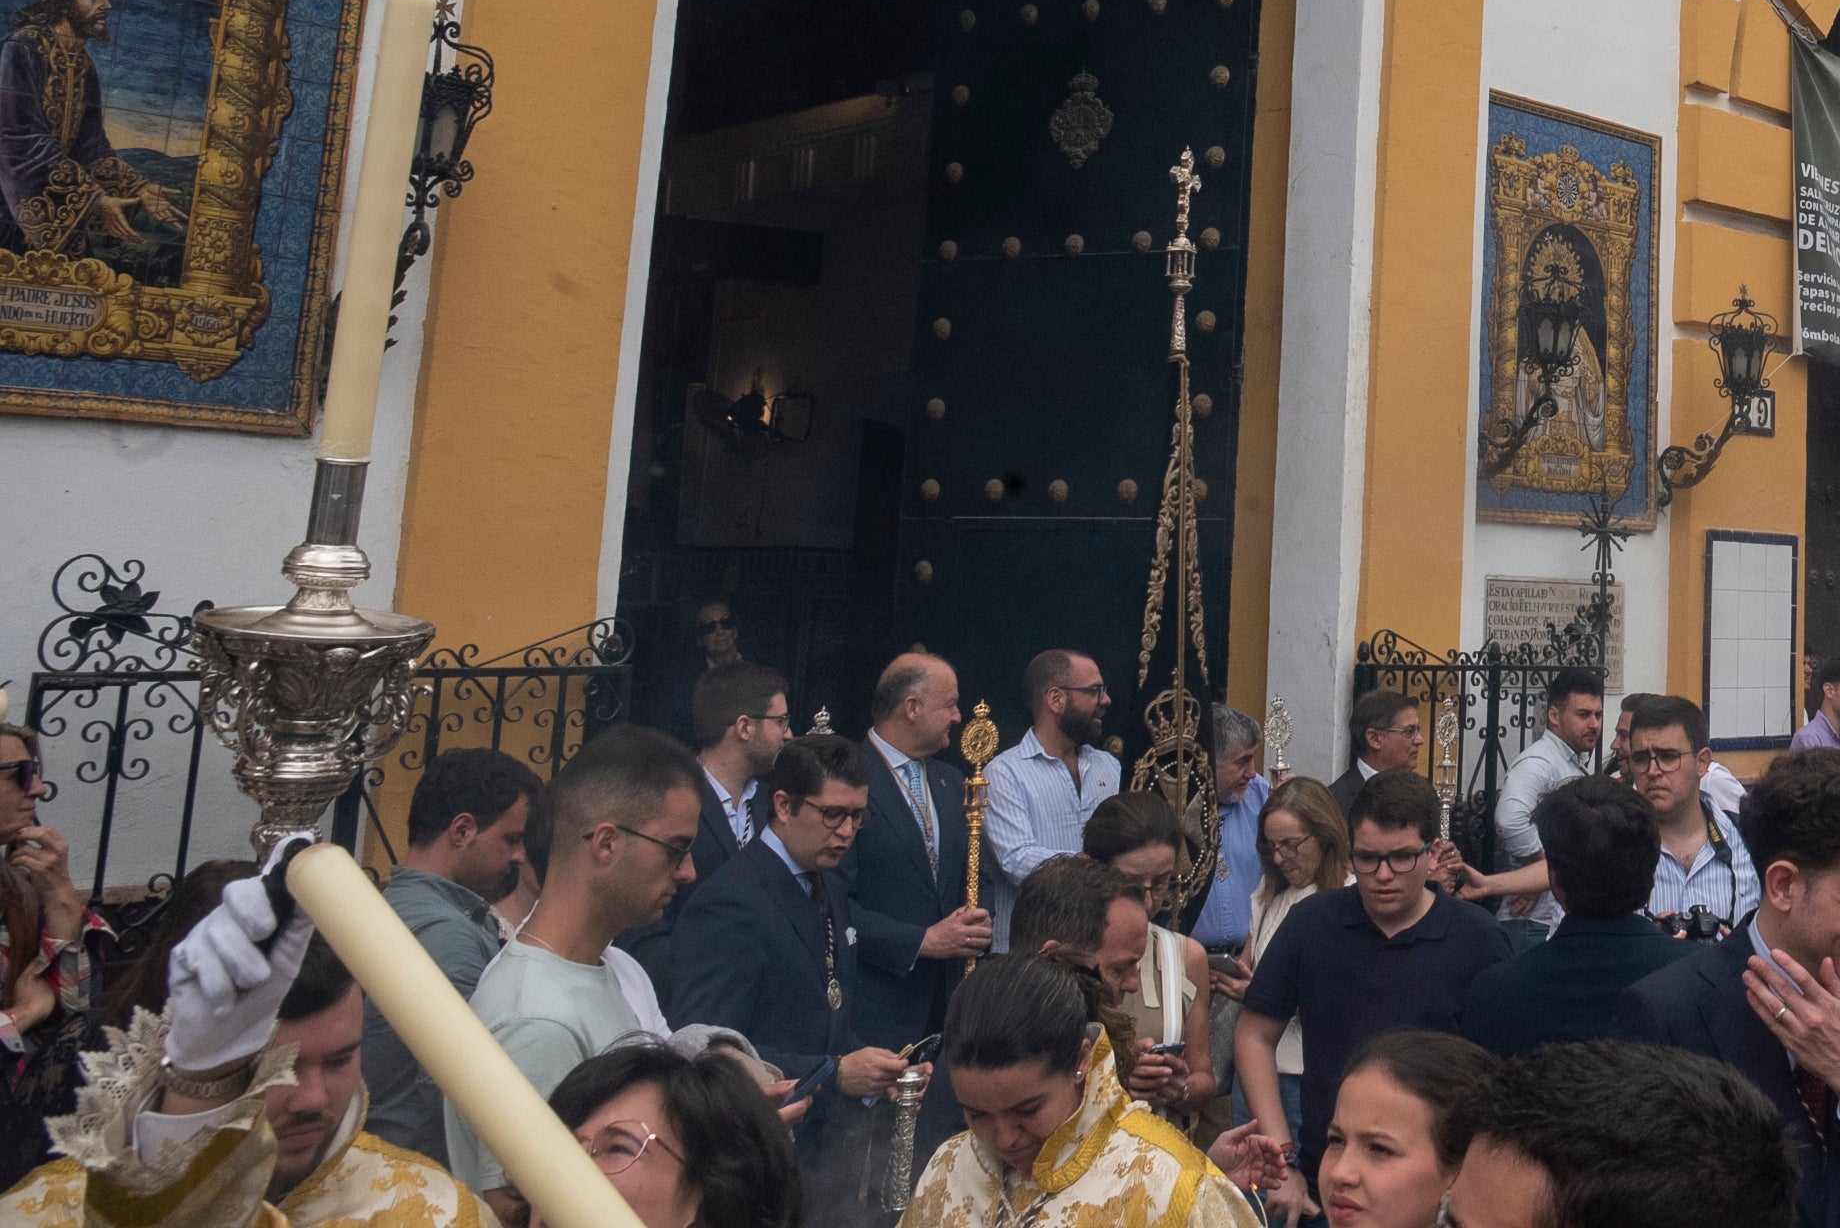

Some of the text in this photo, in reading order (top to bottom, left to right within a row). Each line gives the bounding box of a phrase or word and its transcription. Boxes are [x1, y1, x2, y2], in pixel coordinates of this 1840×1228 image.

[1800, 200, 1819, 211] CON
[1799, 212, 1816, 226] DE
[10, 286, 97, 310] PADRE JESUS
[45, 309, 95, 327] HUERTO
[1800, 327, 1840, 345] ómbola
